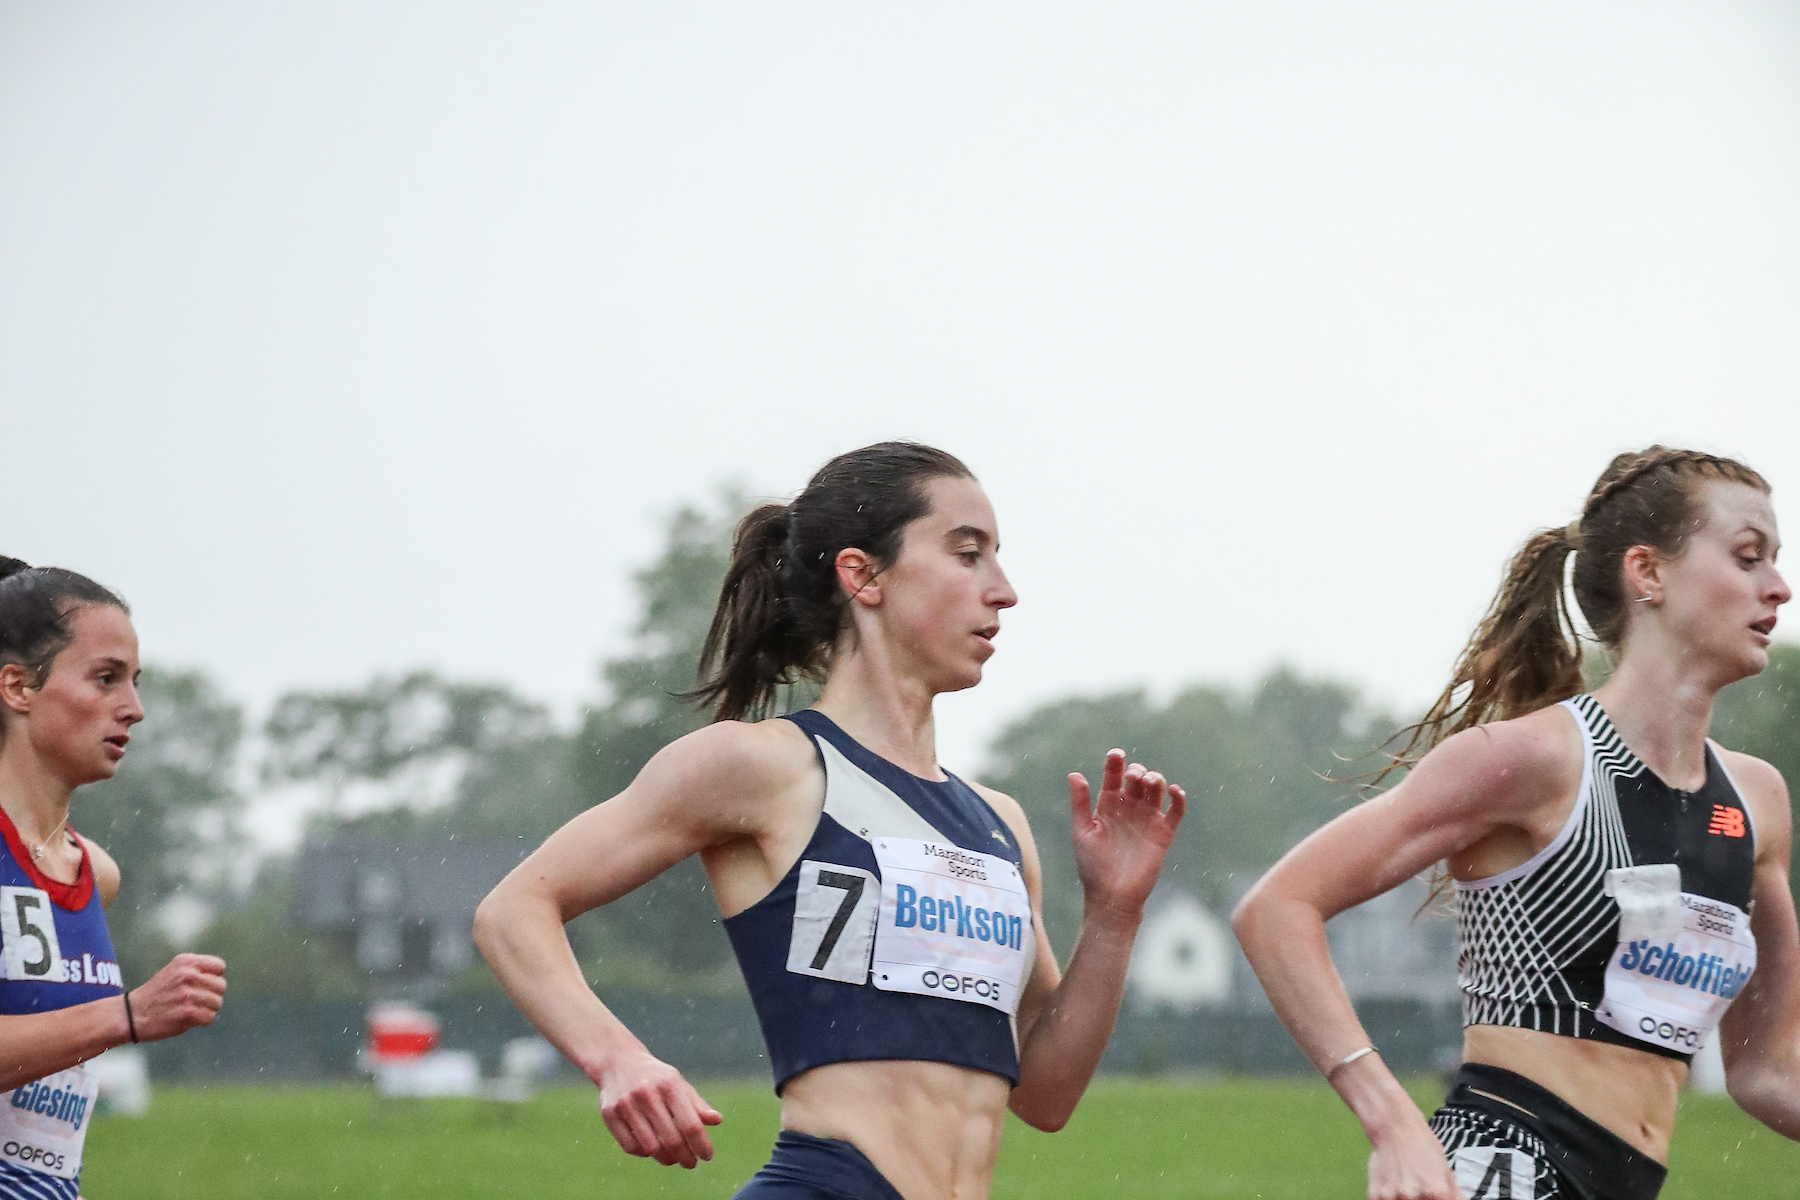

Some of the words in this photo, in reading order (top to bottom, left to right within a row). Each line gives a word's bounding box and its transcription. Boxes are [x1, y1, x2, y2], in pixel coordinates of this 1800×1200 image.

[923, 844, 986, 868] Marathon
[948, 861, 987, 881] Sports
[809, 869, 866, 971] 7
[895, 883, 1022, 951] Berkson
[15, 895, 52, 976] 5
[922, 970, 1000, 1001] OOFOS
[1639, 1016, 1704, 1050] OOFO
[3, 1141, 66, 1170] OOFOS
